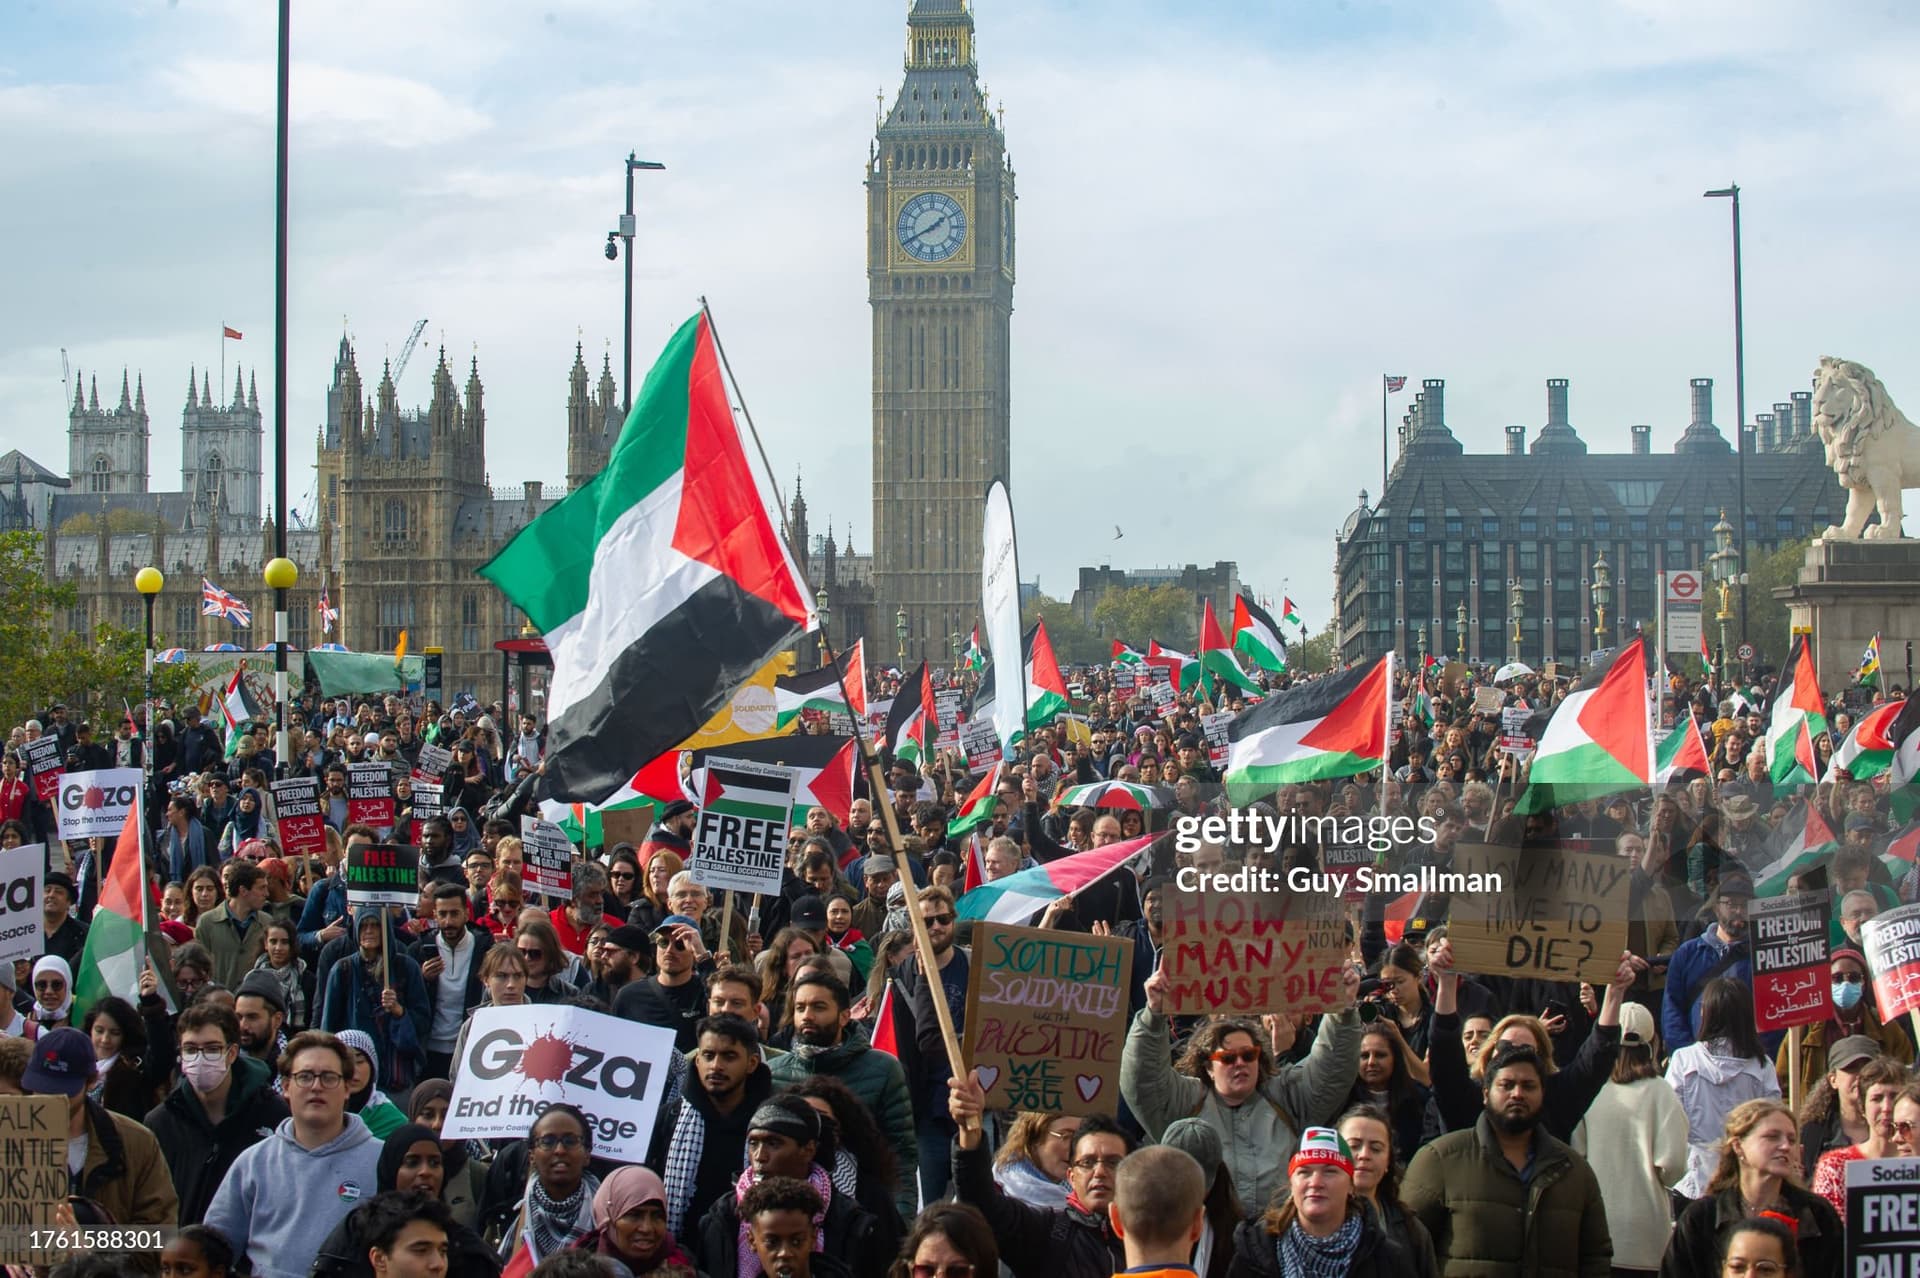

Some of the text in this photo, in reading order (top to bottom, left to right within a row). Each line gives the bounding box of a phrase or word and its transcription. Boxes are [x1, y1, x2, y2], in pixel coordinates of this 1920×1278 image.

[1740, 648, 1752, 656] 20
[734, 704, 776, 713] SOLIDARITY
[30, 744, 57, 761] FREEDOM
[32, 757, 63, 775] PALESTINE
[351, 771, 388, 783] FREEDOM
[277, 787, 314, 801] FREEDOM
[350, 786, 391, 799] PALESTINE
[277, 802, 320, 818] PALESTINE
[63, 818, 80, 826] Stop
[82, 816, 94, 824] the
[699, 812, 785, 854] FREE
[364, 850, 397, 867] FREE
[523, 843, 570, 862] STOP THE WAR
[697, 844, 782, 869] PALESTINE
[348, 865, 417, 885] PALESTINE
[696, 860, 779, 879] END ISRAELI OCCUPATION
[1468, 855, 1627, 898] HOW MANY
[1174, 892, 1293, 938] HOW
[1760, 899, 1793, 911] Socialist
[1486, 898, 1602, 934] HAVE TO
[1757, 909, 1822, 939] FREEDOM
[1308, 932, 1345, 949] NOW
[1787, 934, 1799, 945] for
[985, 934, 1123, 985] SCOTTISH
[1176, 938, 1307, 976] MANY
[1506, 935, 1594, 978] DIE?
[1756, 939, 1827, 971] PALESTINE
[1170, 966, 1345, 1012] MUST DIE
[1770, 971, 1816, 996] الحرية
[979, 971, 1122, 1018] SOLIDARITY
[1765, 990, 1823, 1020] لفلسطين
[975, 1018, 1117, 1062] PALESTINE
[1008, 1057, 1065, 1079] WE
[1003, 1077, 1065, 1094] SEE
[455, 1095, 504, 1118] End
[1007, 1090, 1063, 1111] YOU
[459, 1125, 476, 1133] Stop
[5, 1138, 65, 1168] IN THE
[1295, 1149, 1347, 1166] PALESTINE
[32, 1168, 68, 1201] AND
[1862, 1193, 1920, 1234] FRE
